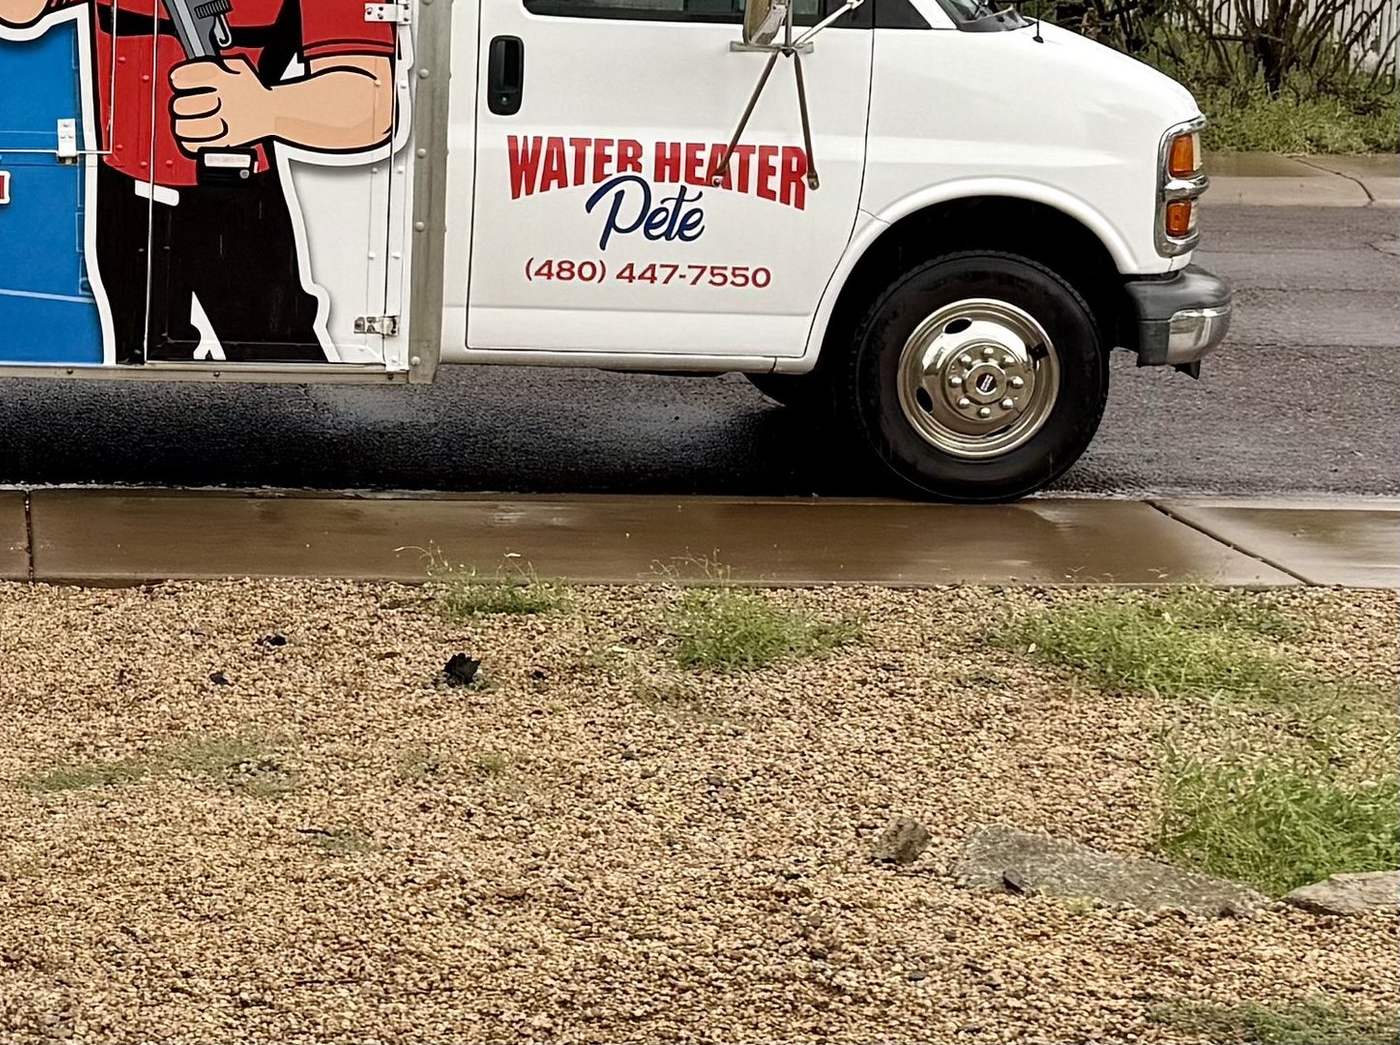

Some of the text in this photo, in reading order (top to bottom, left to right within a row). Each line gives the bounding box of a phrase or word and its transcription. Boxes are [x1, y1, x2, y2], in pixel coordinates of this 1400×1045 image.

[507, 135, 812, 211] WATER HEATER
[585, 175, 705, 251] Pete
[524, 257, 772, 289] (480) 447-7550
